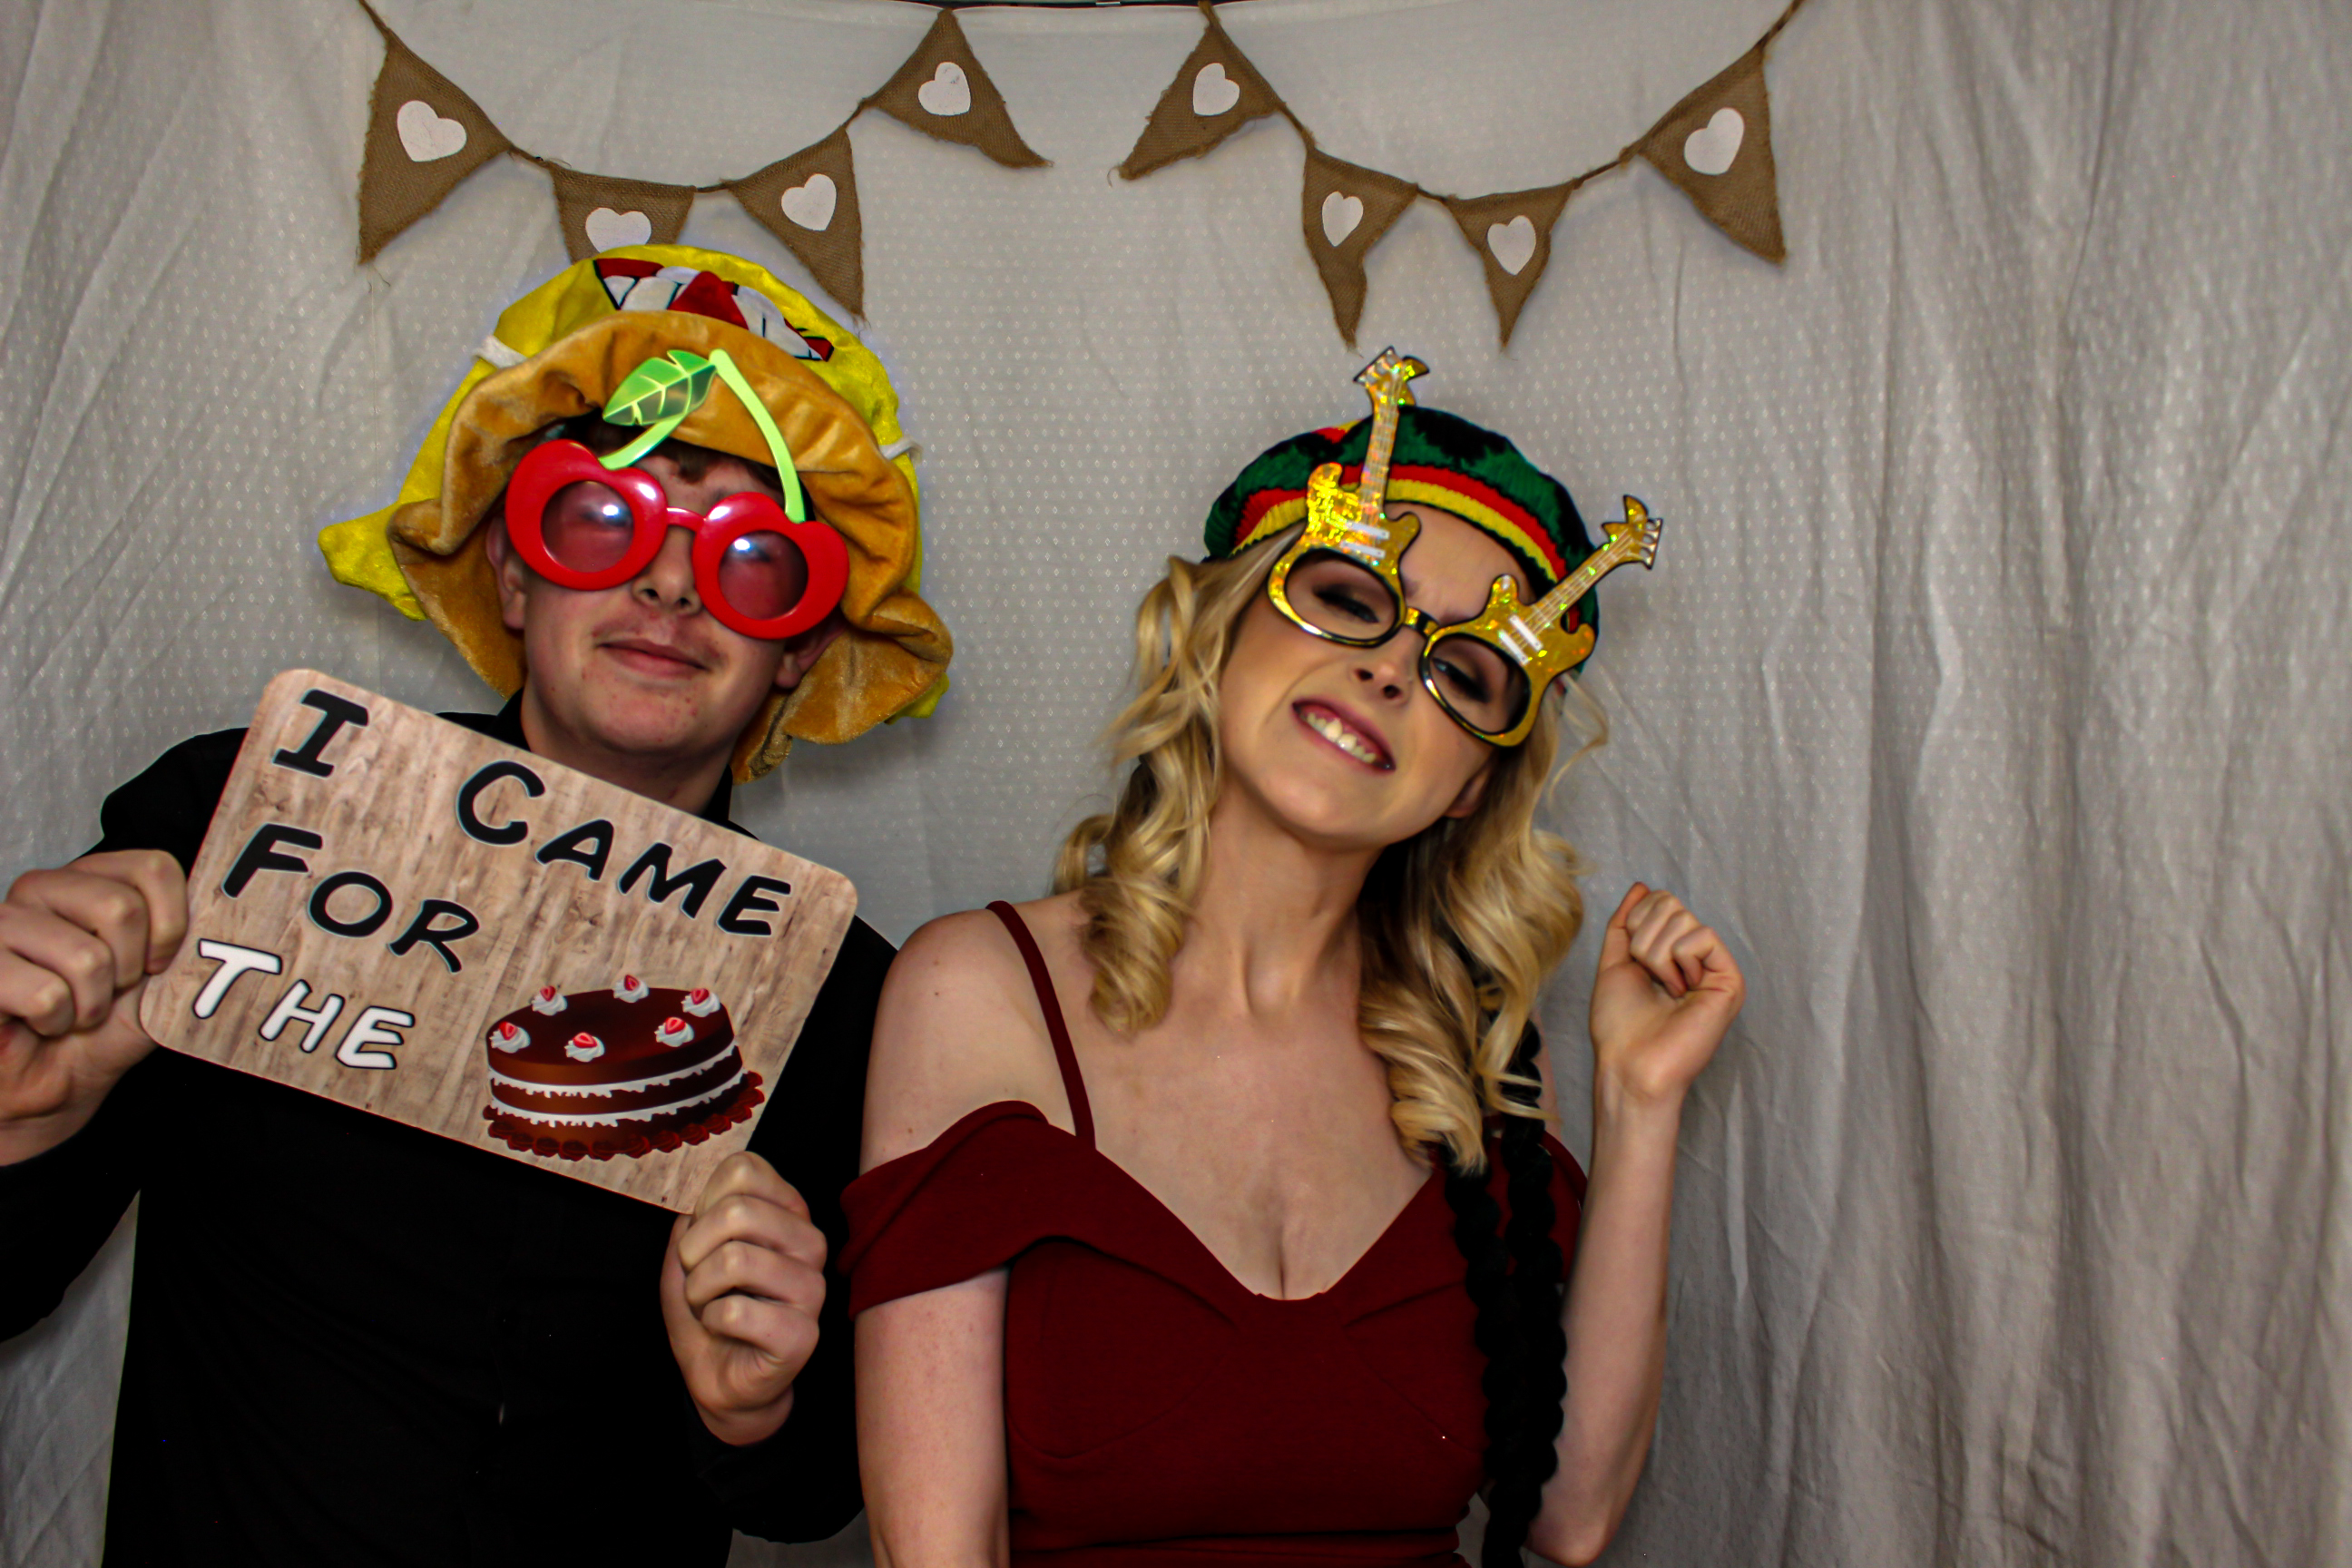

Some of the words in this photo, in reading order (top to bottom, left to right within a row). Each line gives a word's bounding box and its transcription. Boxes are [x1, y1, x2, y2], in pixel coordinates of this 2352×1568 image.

[271, 688, 369, 779] I
[455, 760, 792, 936] CAME
[222, 823, 480, 974] FOR
[192, 937, 416, 1070] THE
